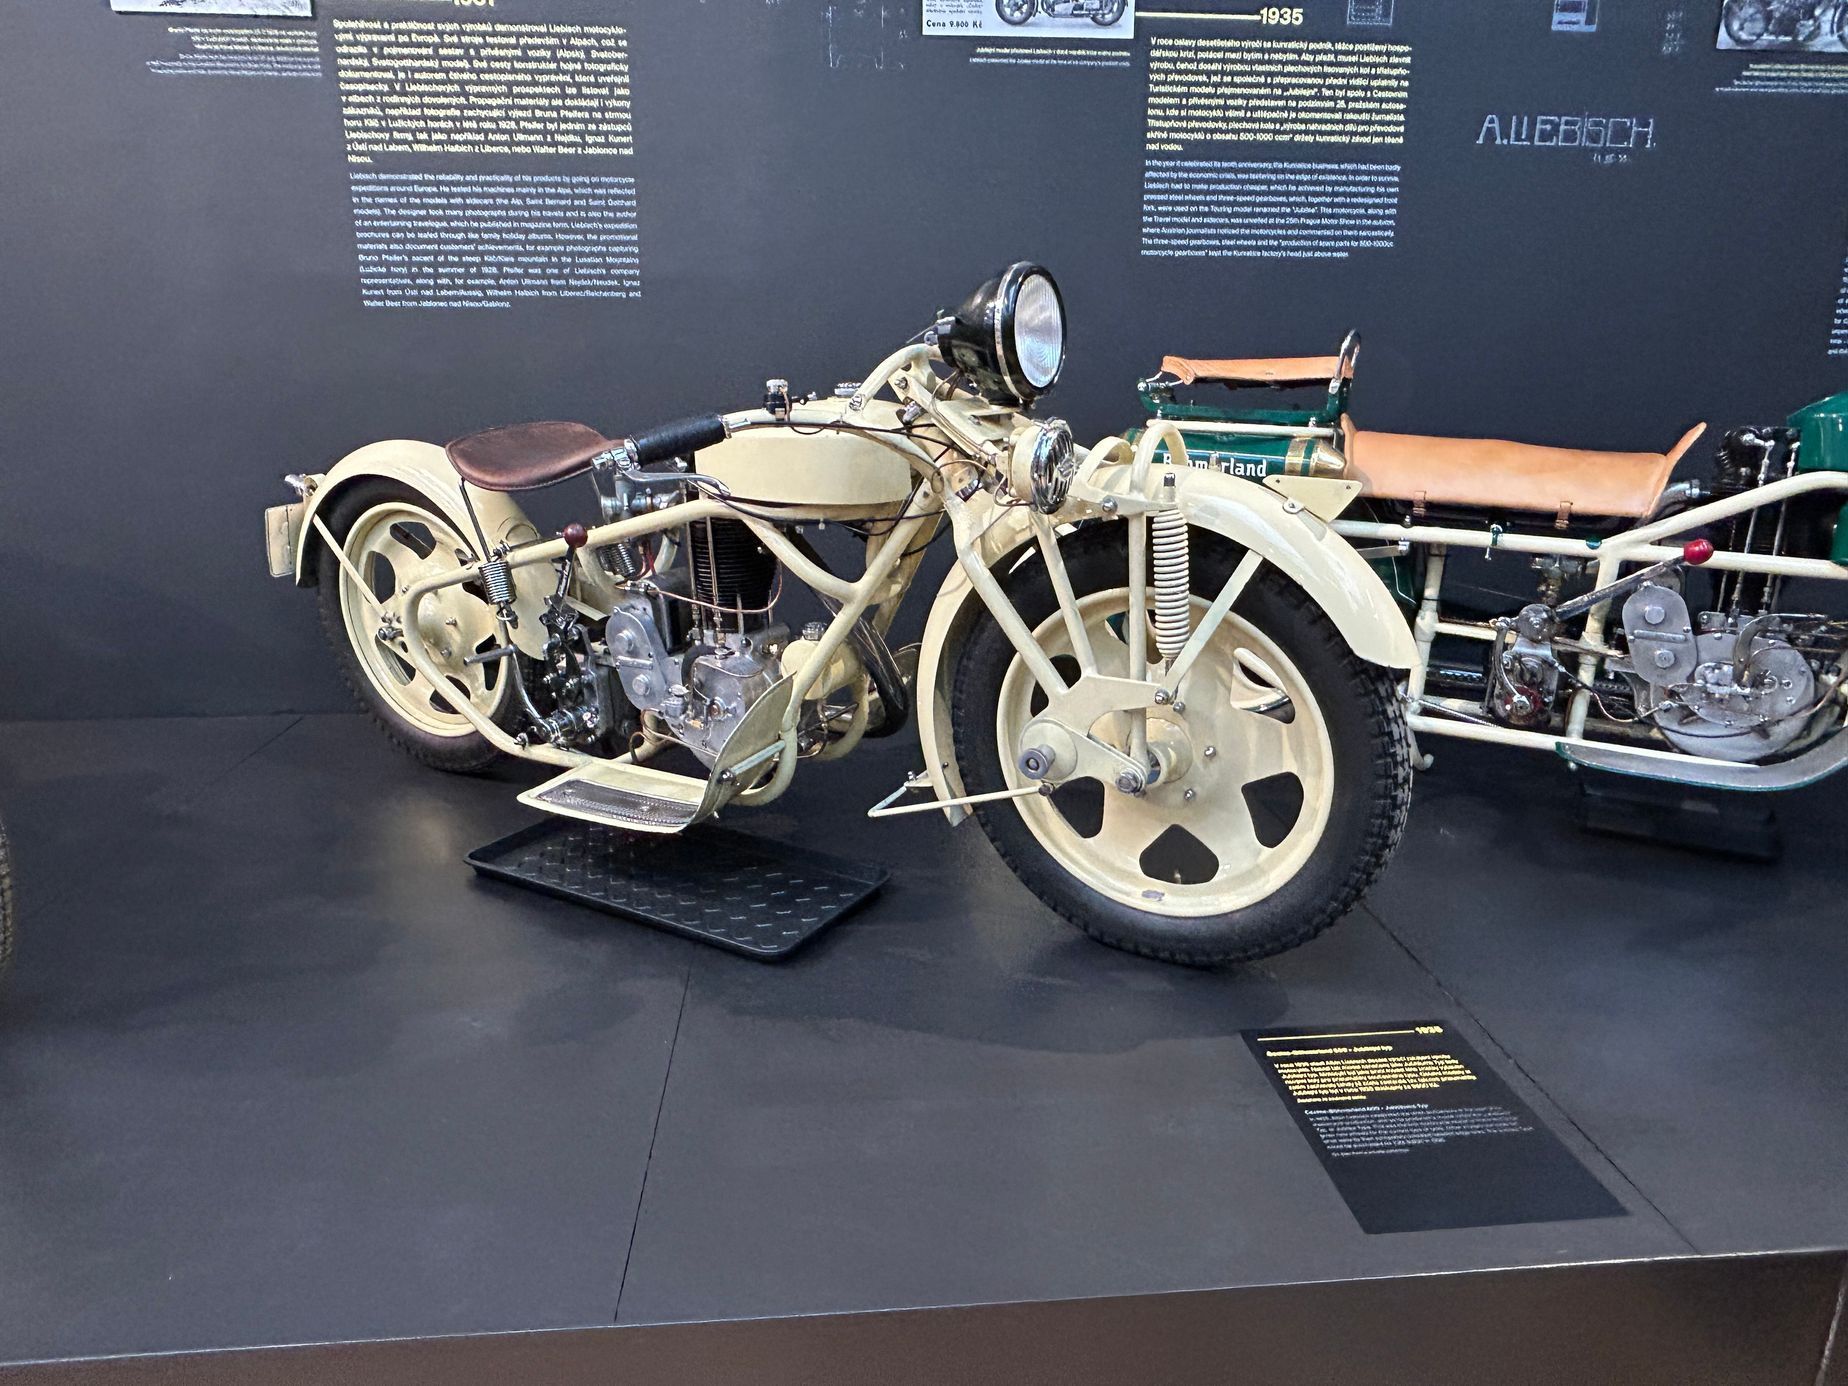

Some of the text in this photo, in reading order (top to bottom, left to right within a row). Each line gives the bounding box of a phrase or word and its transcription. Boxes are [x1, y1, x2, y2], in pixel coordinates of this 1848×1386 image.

[926, 19, 946, 28] Cena
[1260, 7, 1304, 26] 1935
[1163, 453, 1267, 477] Bhmrland
